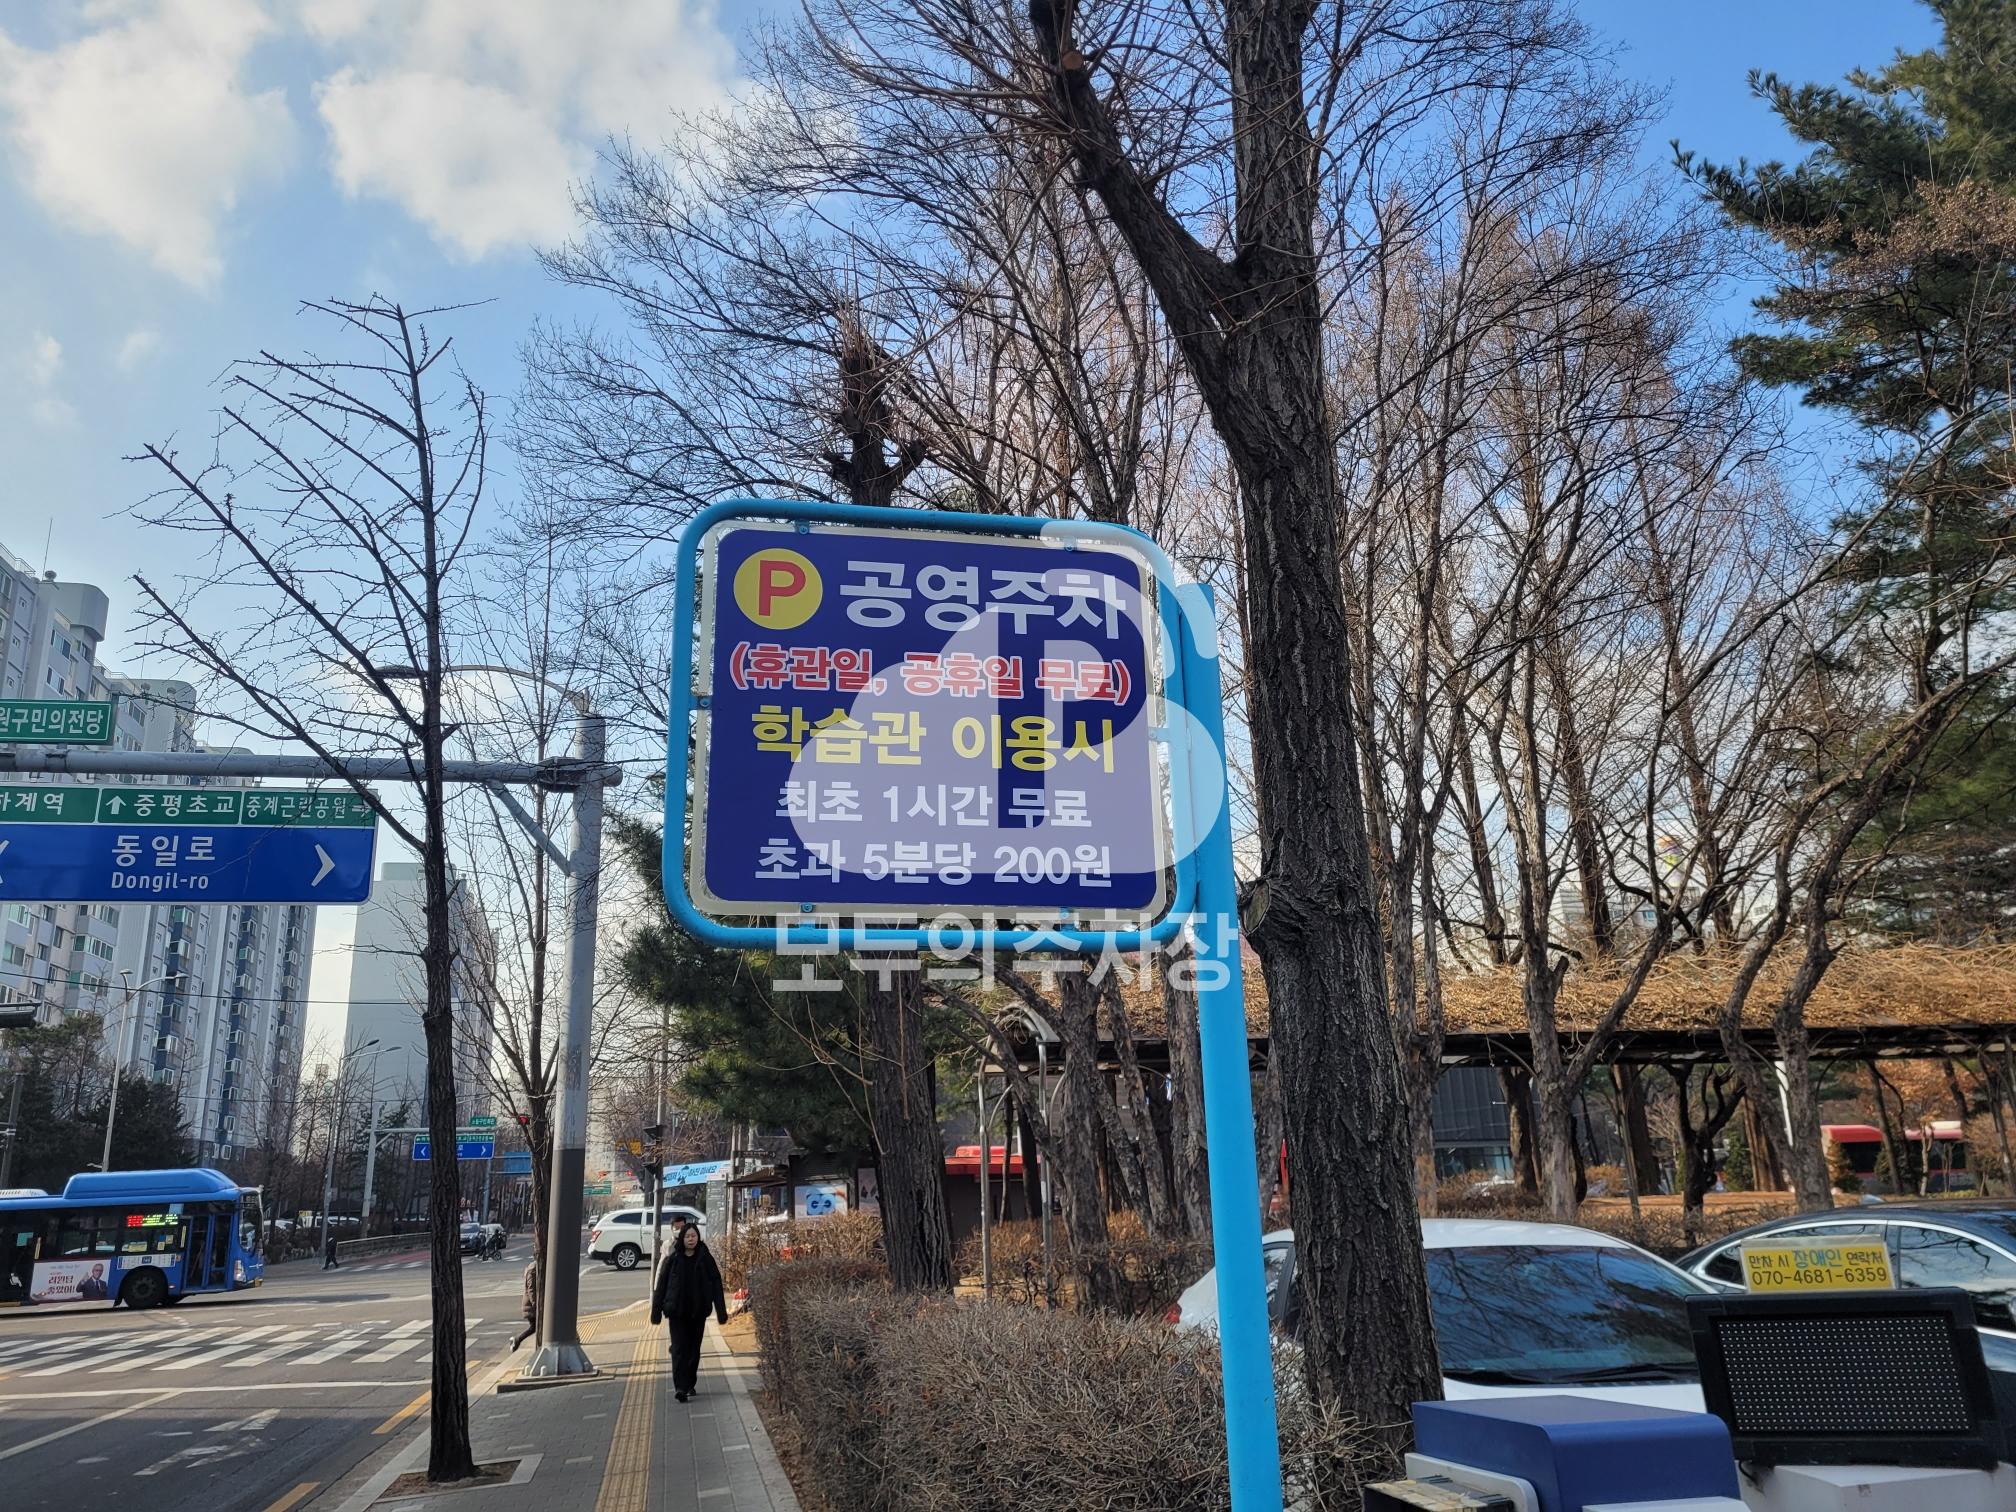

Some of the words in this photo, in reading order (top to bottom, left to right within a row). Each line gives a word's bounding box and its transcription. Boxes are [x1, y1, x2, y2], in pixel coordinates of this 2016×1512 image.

[758, 559, 807, 617] P
[839, 560, 1126, 640] 공영주차
[729, 641, 888, 697] (휴관일,
[899, 652, 1025, 700] 공휴일
[1035, 657, 1132, 706] 무료)
[751, 704, 927, 766] 학습관
[951, 714, 1115, 774] 이용시
[133, 794, 235, 817] 중평초교
[246, 796, 346, 819] 중계근린공원
[775, 780, 863, 823] 최초
[882, 783, 993, 827] 1시간
[1007, 787, 1093, 829] 무료
[111, 834, 216, 867] 동일로
[754, 837, 847, 884] 초과
[862, 840, 977, 886] 5분당
[993, 844, 1112, 888] 200원
[111, 871, 209, 893] Dongil-ro
[1748, 1255, 1774, 1269] 만차
[1778, 1254, 1790, 1268] 시
[1792, 1248, 1843, 1269] 장애인
[1846, 1250, 1884, 1267] 연락처
[1752, 1267, 1888, 1286] 070-4681-6359
